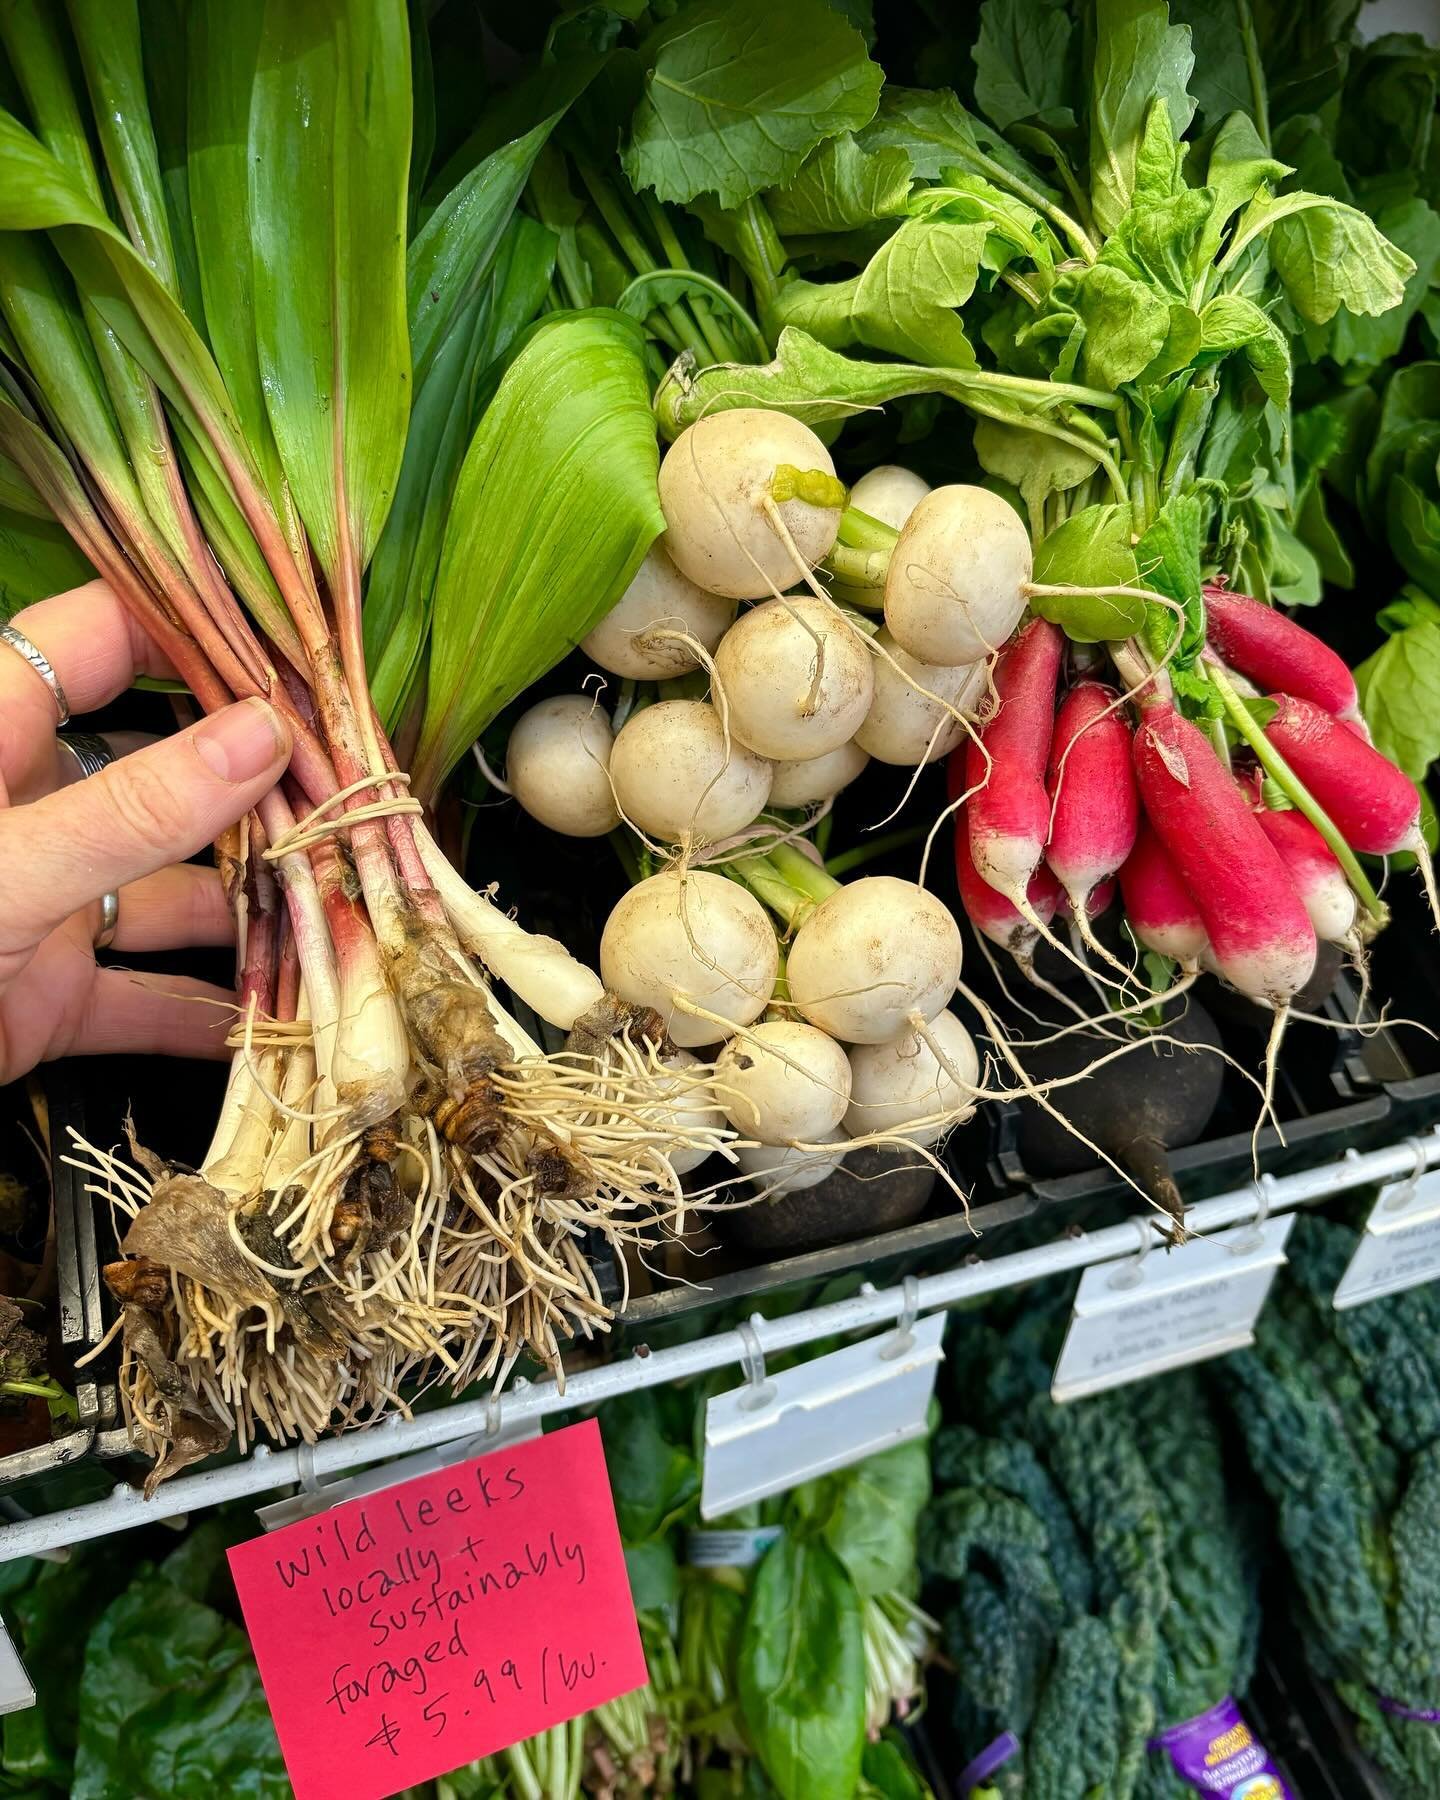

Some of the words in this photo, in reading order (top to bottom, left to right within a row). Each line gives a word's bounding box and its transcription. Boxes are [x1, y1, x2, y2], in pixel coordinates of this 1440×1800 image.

[276, 1513, 377, 1588] wild
[397, 1467, 526, 1533] leeks
[323, 1545, 441, 1617] locally
[370, 1531, 586, 1647] sustainably
[326, 1618, 469, 1715] foraged
